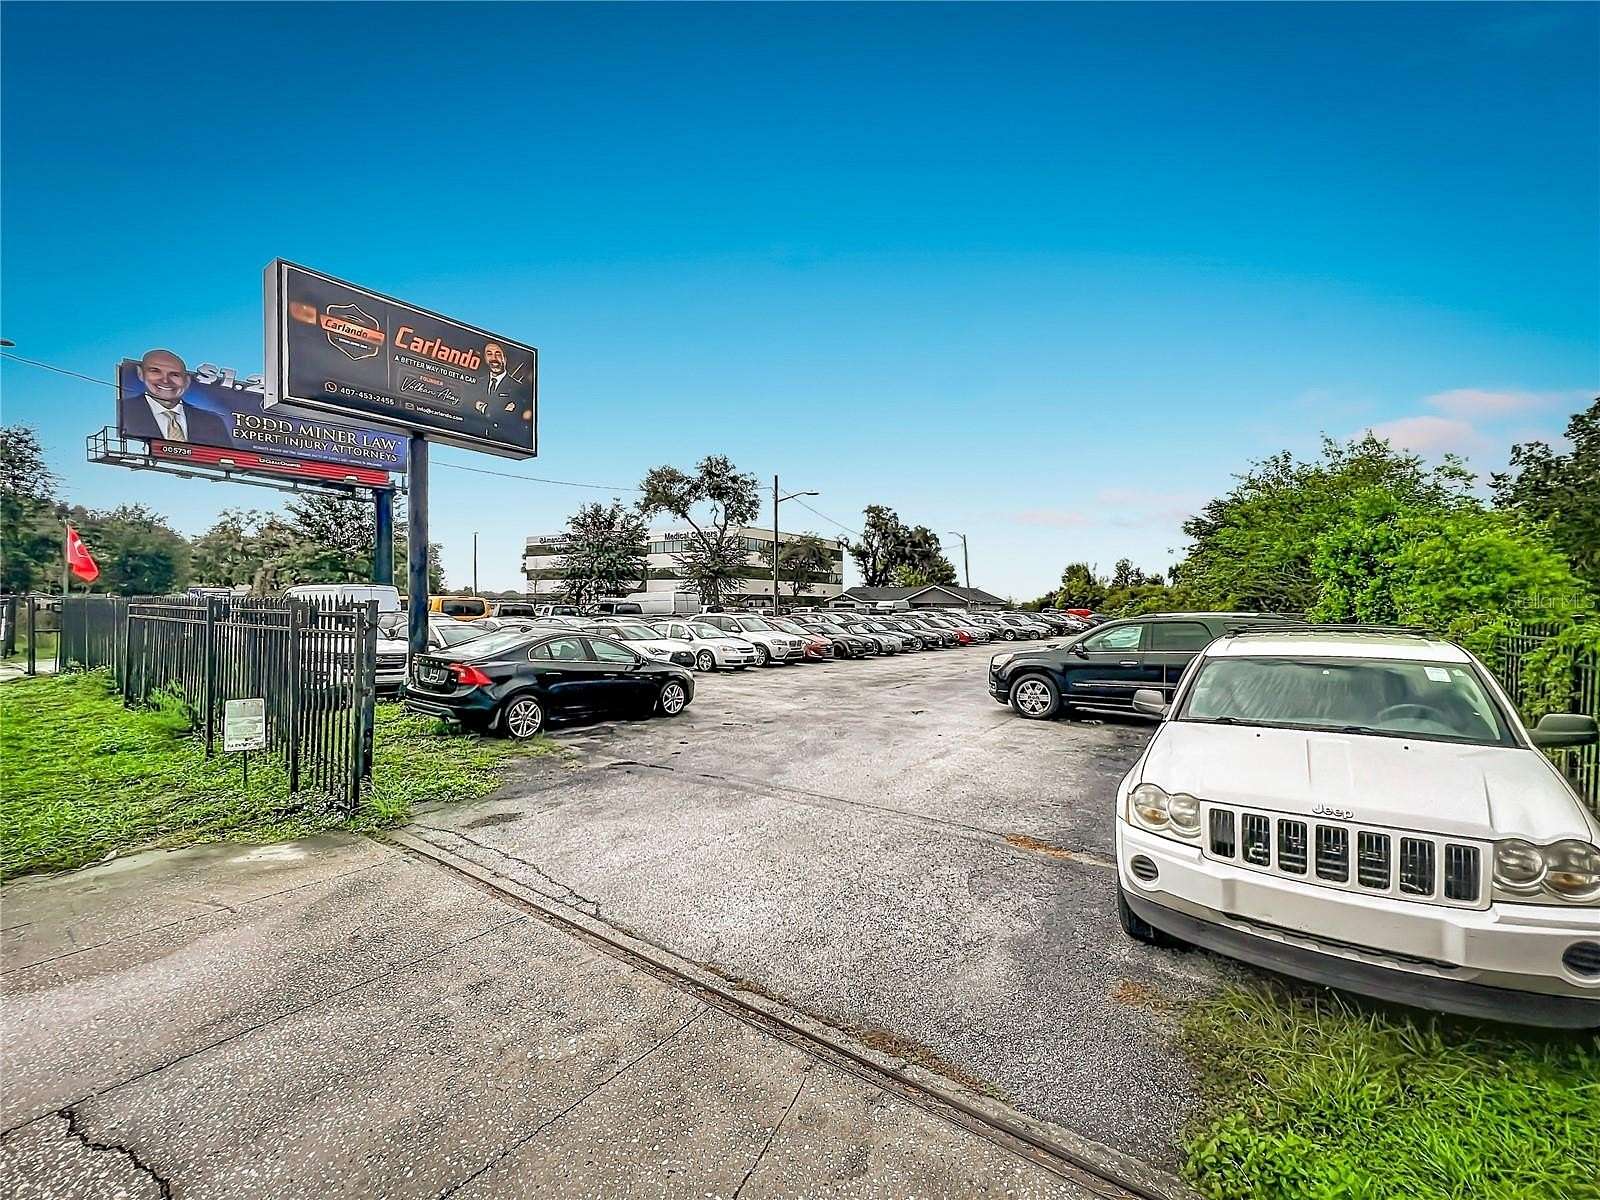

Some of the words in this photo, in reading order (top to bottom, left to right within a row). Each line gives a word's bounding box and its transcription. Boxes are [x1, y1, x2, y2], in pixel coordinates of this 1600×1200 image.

[325, 319, 369, 339] Carlando
[394, 326, 481, 371] Carlando
[400, 356, 425, 368] BETTER
[425, 363, 440, 373] WAY
[440, 368, 448, 376] TO
[448, 369, 460, 380] GET
[465, 374, 477, 384] CAR
[231, 412, 294, 434] TODD
[298, 424, 359, 445] MINER
[363, 434, 397, 450] LAW
[232, 429, 282, 445] EXPERT
[284, 436, 329, 450] INJURY
[331, 445, 398, 462] ATTORNEYS
[664, 531, 689, 540] Medical
[691, 530, 718, 539] Ceters
[1311, 799, 1354, 819] Jeep
